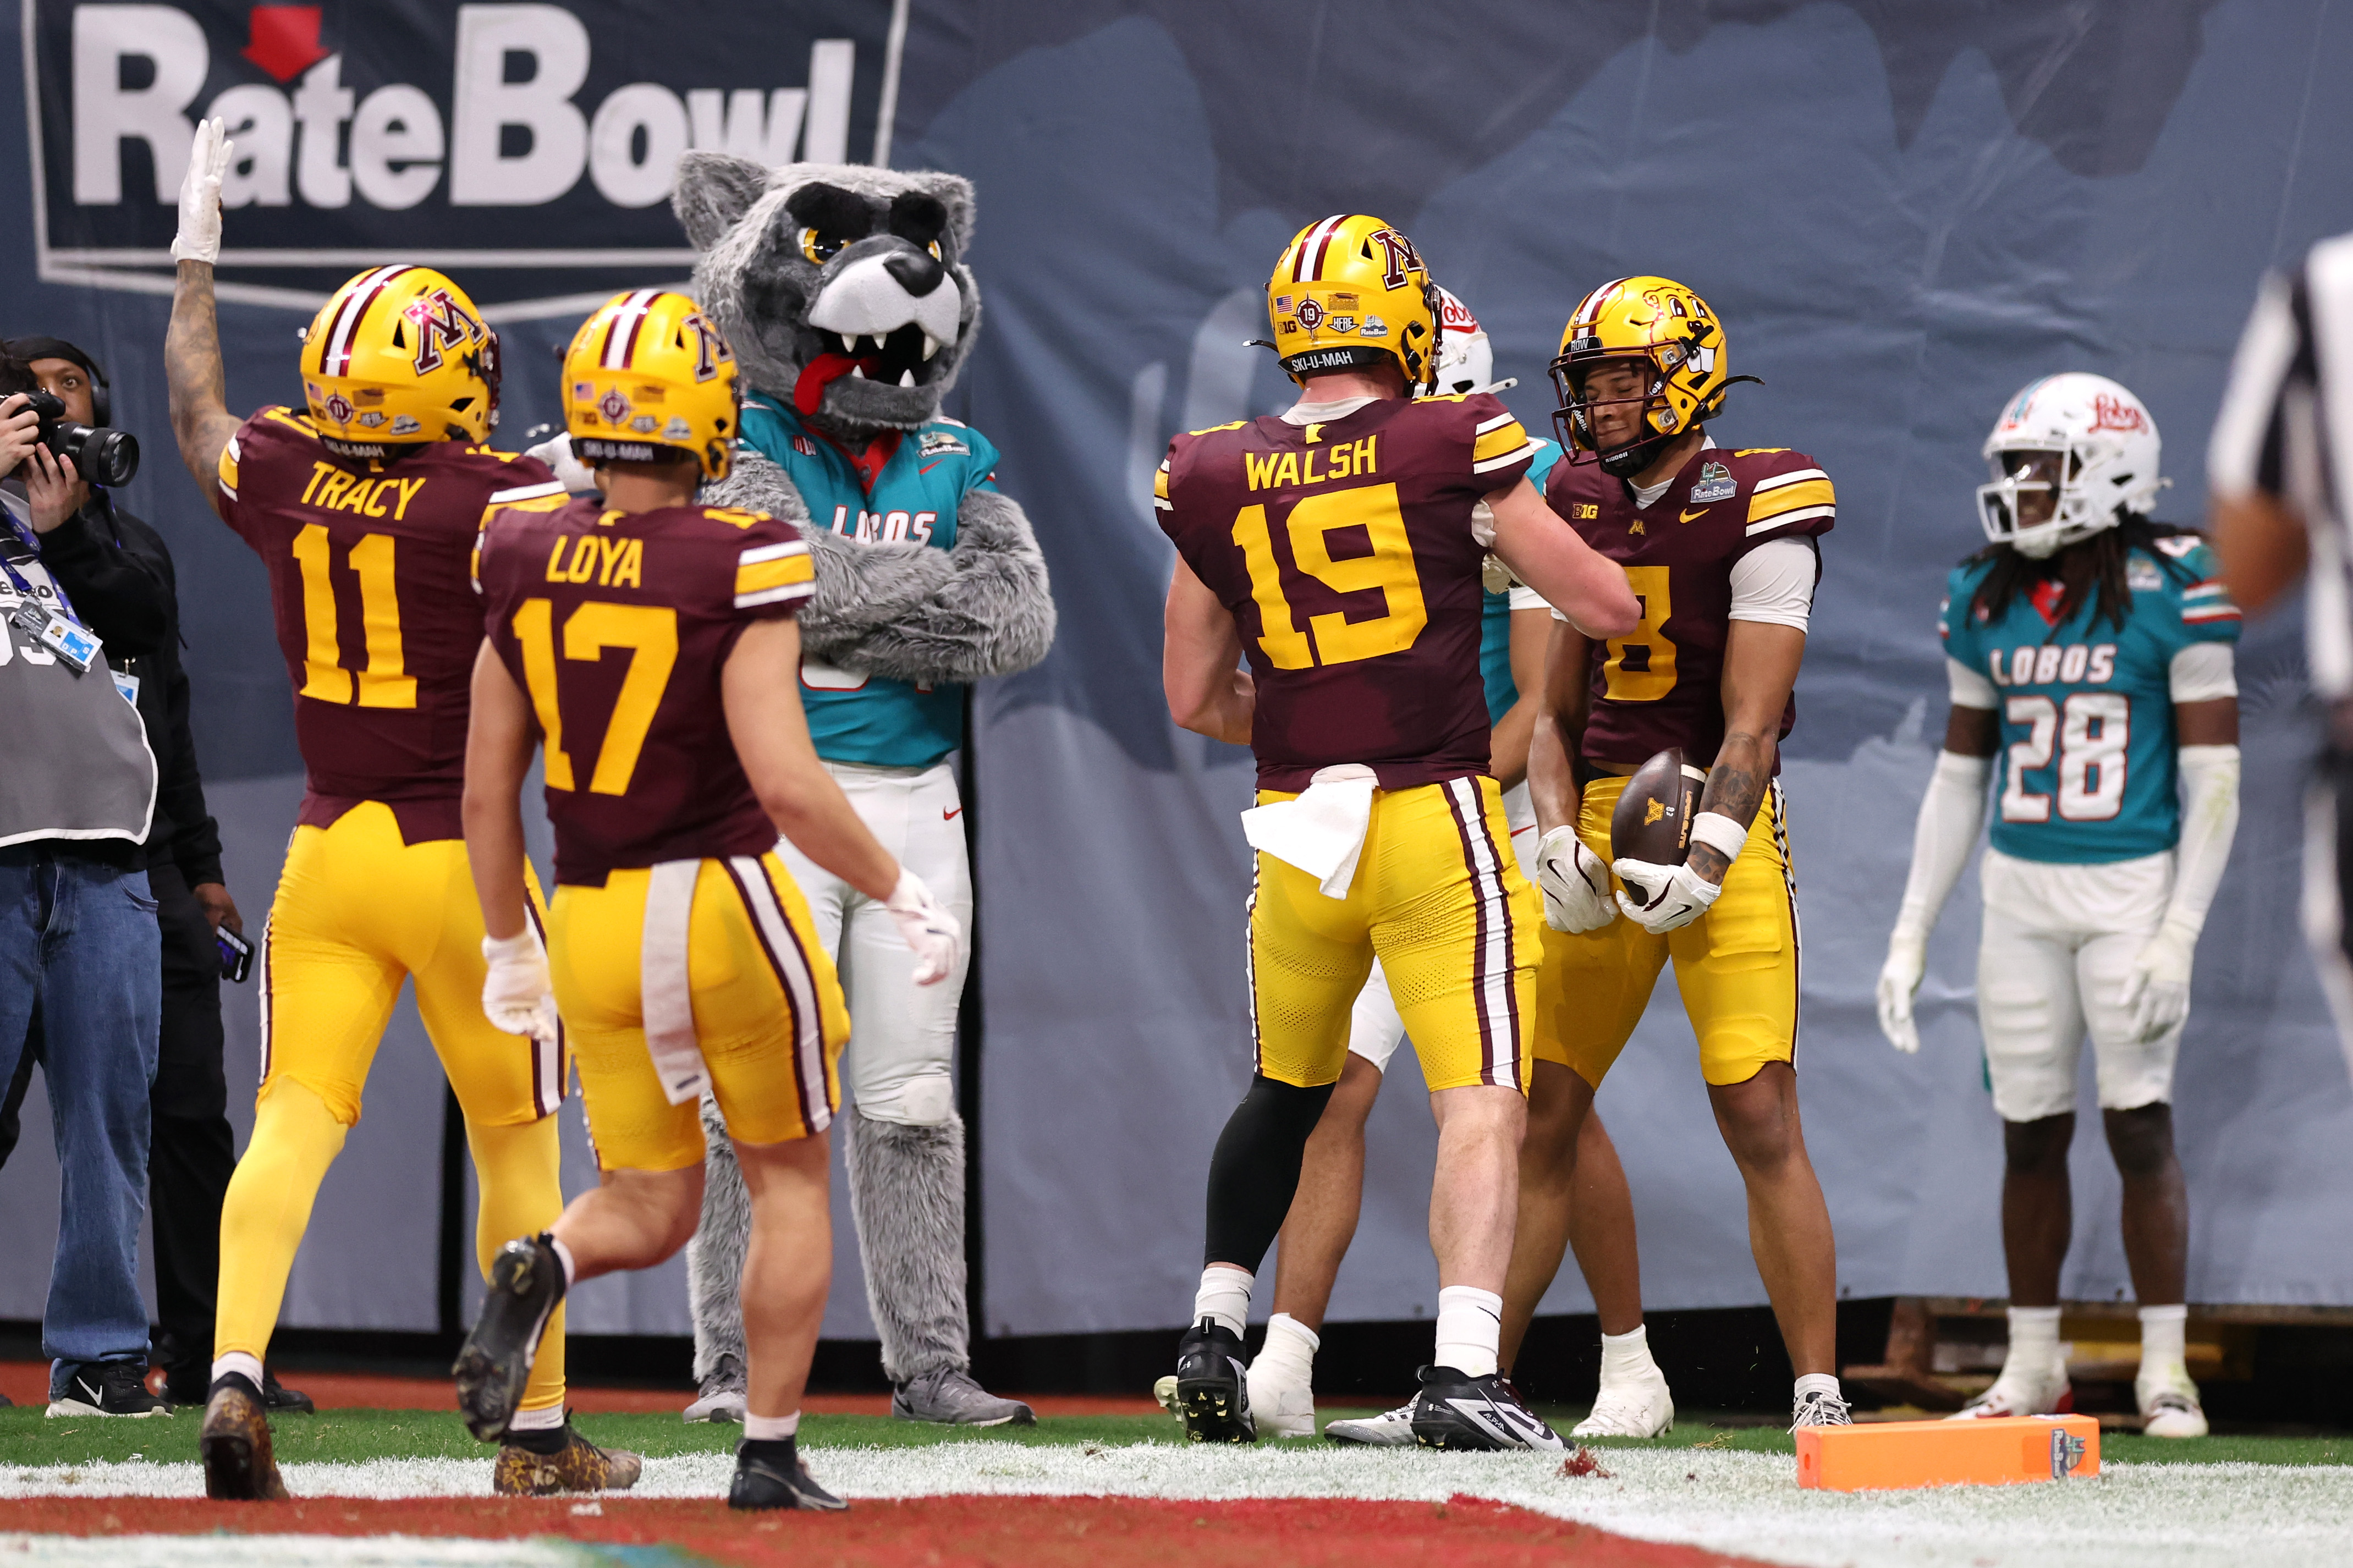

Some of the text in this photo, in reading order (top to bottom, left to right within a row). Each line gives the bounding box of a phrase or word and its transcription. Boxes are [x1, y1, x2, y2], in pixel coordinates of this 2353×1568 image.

[404, 288, 485, 376] M
[1302, 307, 1316, 322] 19
[1333, 317, 1353, 331] HERE
[1291, 351, 1354, 372] SKI-U-MAH
[1570, 339, 1588, 352] ROW
[301, 460, 427, 520] TRACY
[1245, 434, 1377, 491] WALSH
[546, 535, 644, 588] LOYA
[1231, 482, 1428, 670] 19
[292, 523, 417, 709] 11
[1603, 566, 1678, 701] 8
[1989, 643, 2118, 687] LOBOS
[512, 598, 679, 796] 17
[2000, 692, 2131, 823] 28
[1483, 1412, 1505, 1432] ALPHA
